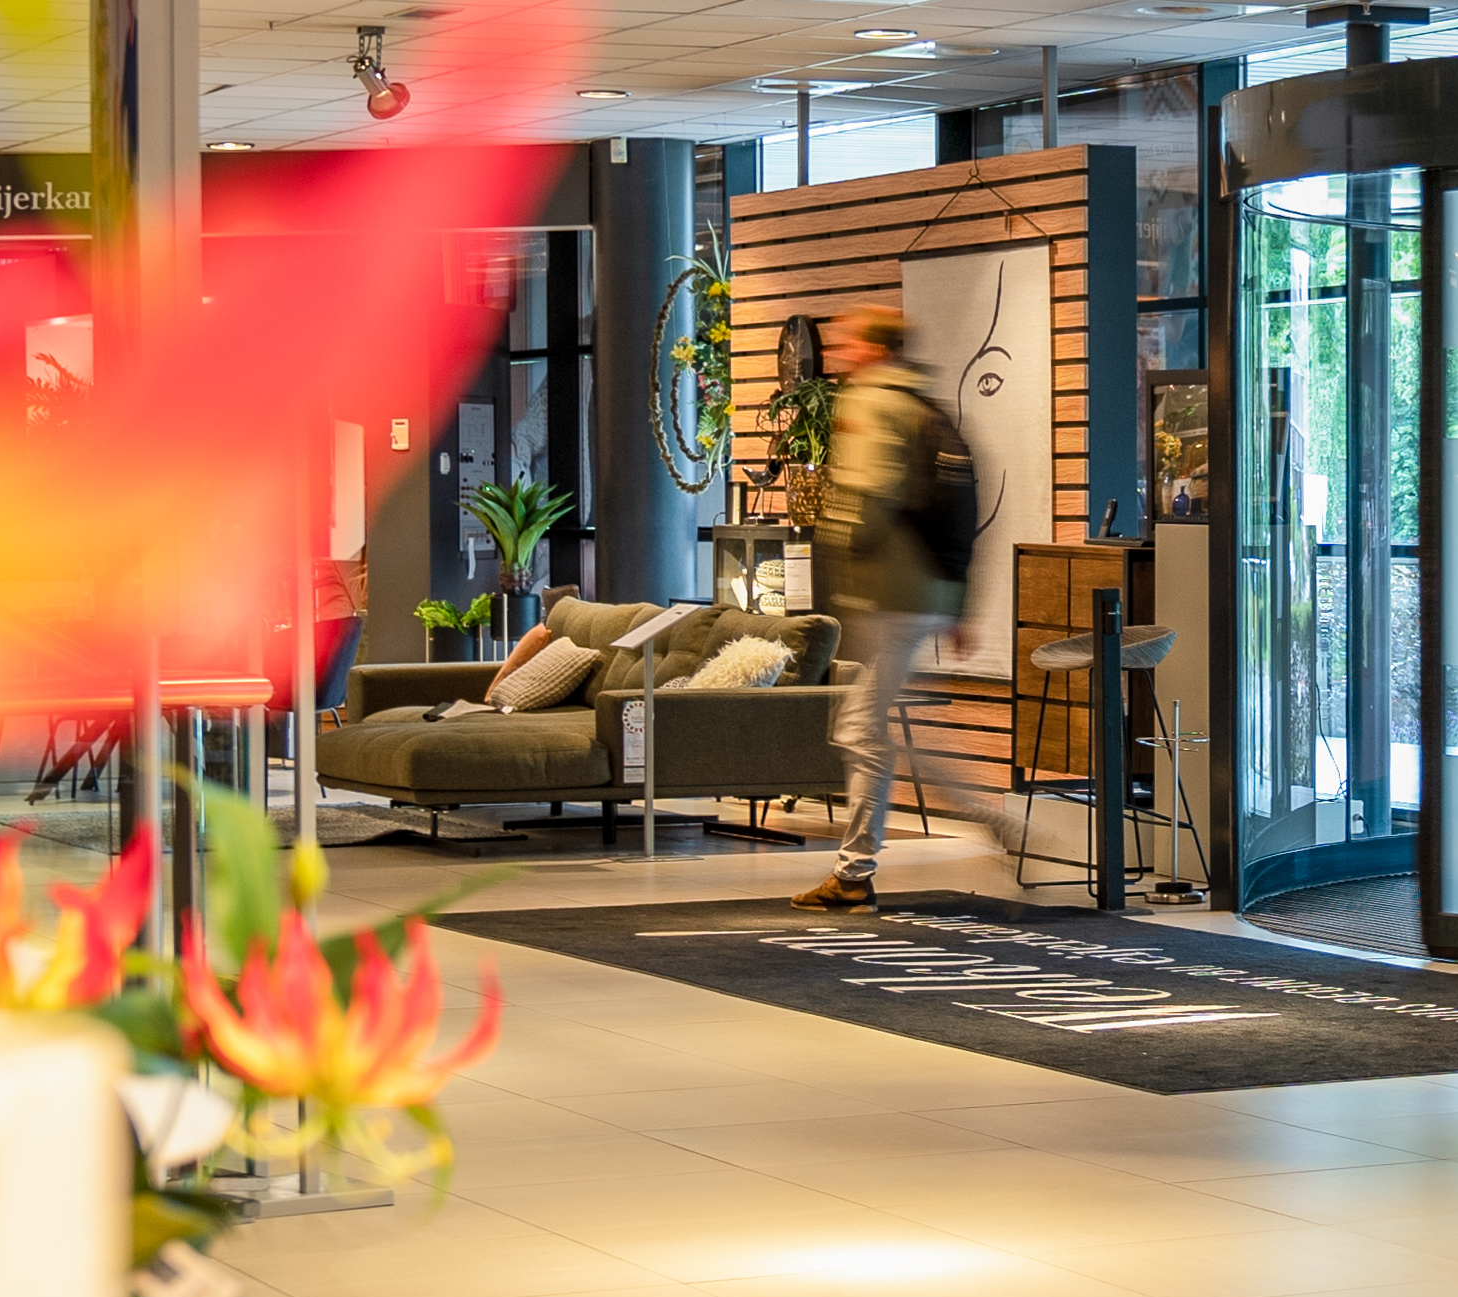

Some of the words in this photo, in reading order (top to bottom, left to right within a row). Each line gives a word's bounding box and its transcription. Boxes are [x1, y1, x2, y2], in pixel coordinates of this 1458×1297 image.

[635, 926, 1283, 1034] Welkom!
[1154, 965, 1250, 976] BIJ
[1217, 976, 1400, 1003] BEGINT
